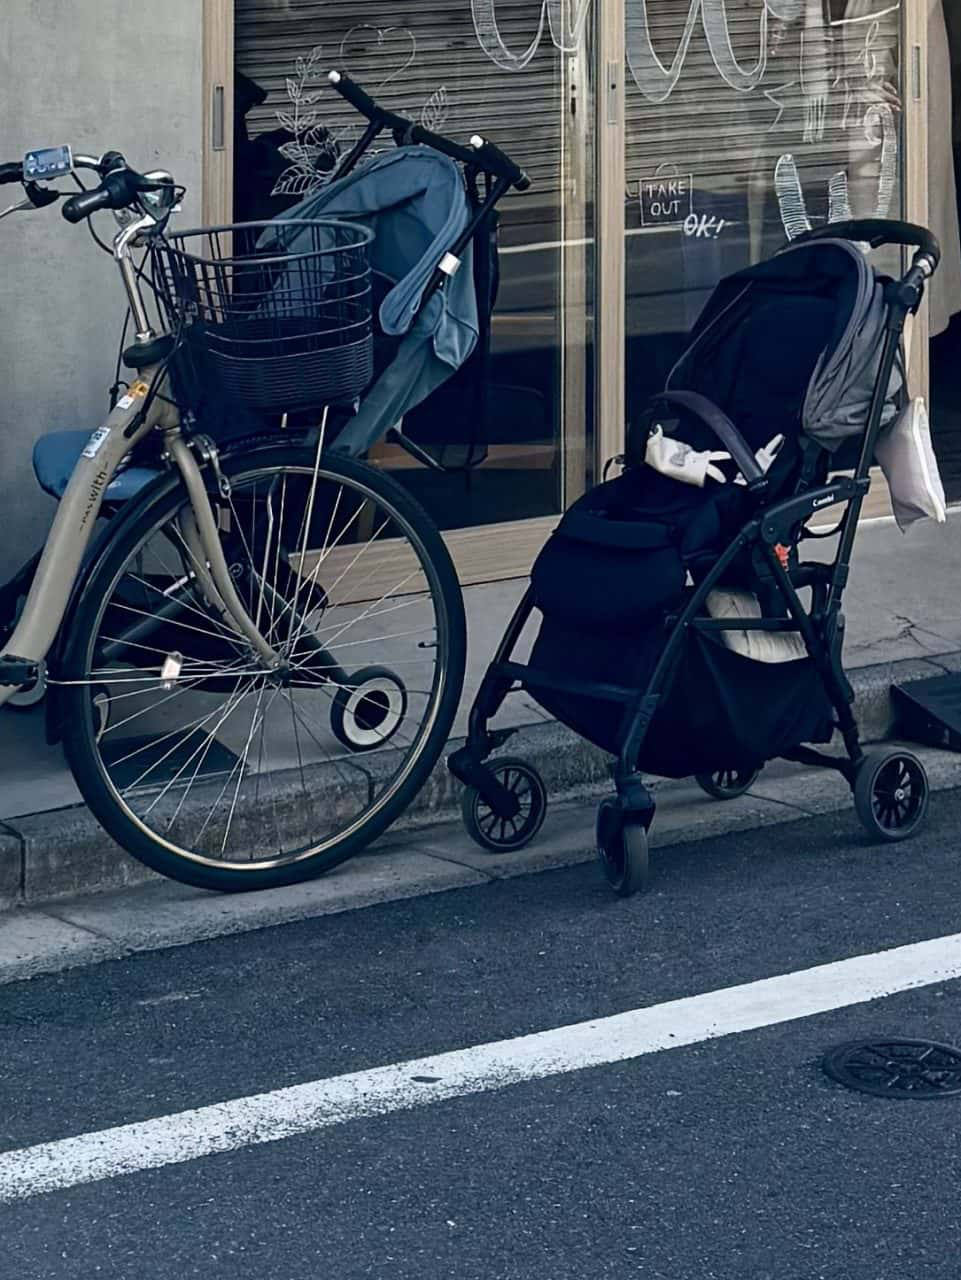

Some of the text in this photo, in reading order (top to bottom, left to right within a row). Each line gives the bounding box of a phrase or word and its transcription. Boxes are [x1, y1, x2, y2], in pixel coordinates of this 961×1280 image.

[644, 181, 688, 199] TAKE
[650, 200, 681, 216] OUT
[683, 213, 725, 239] OK!
